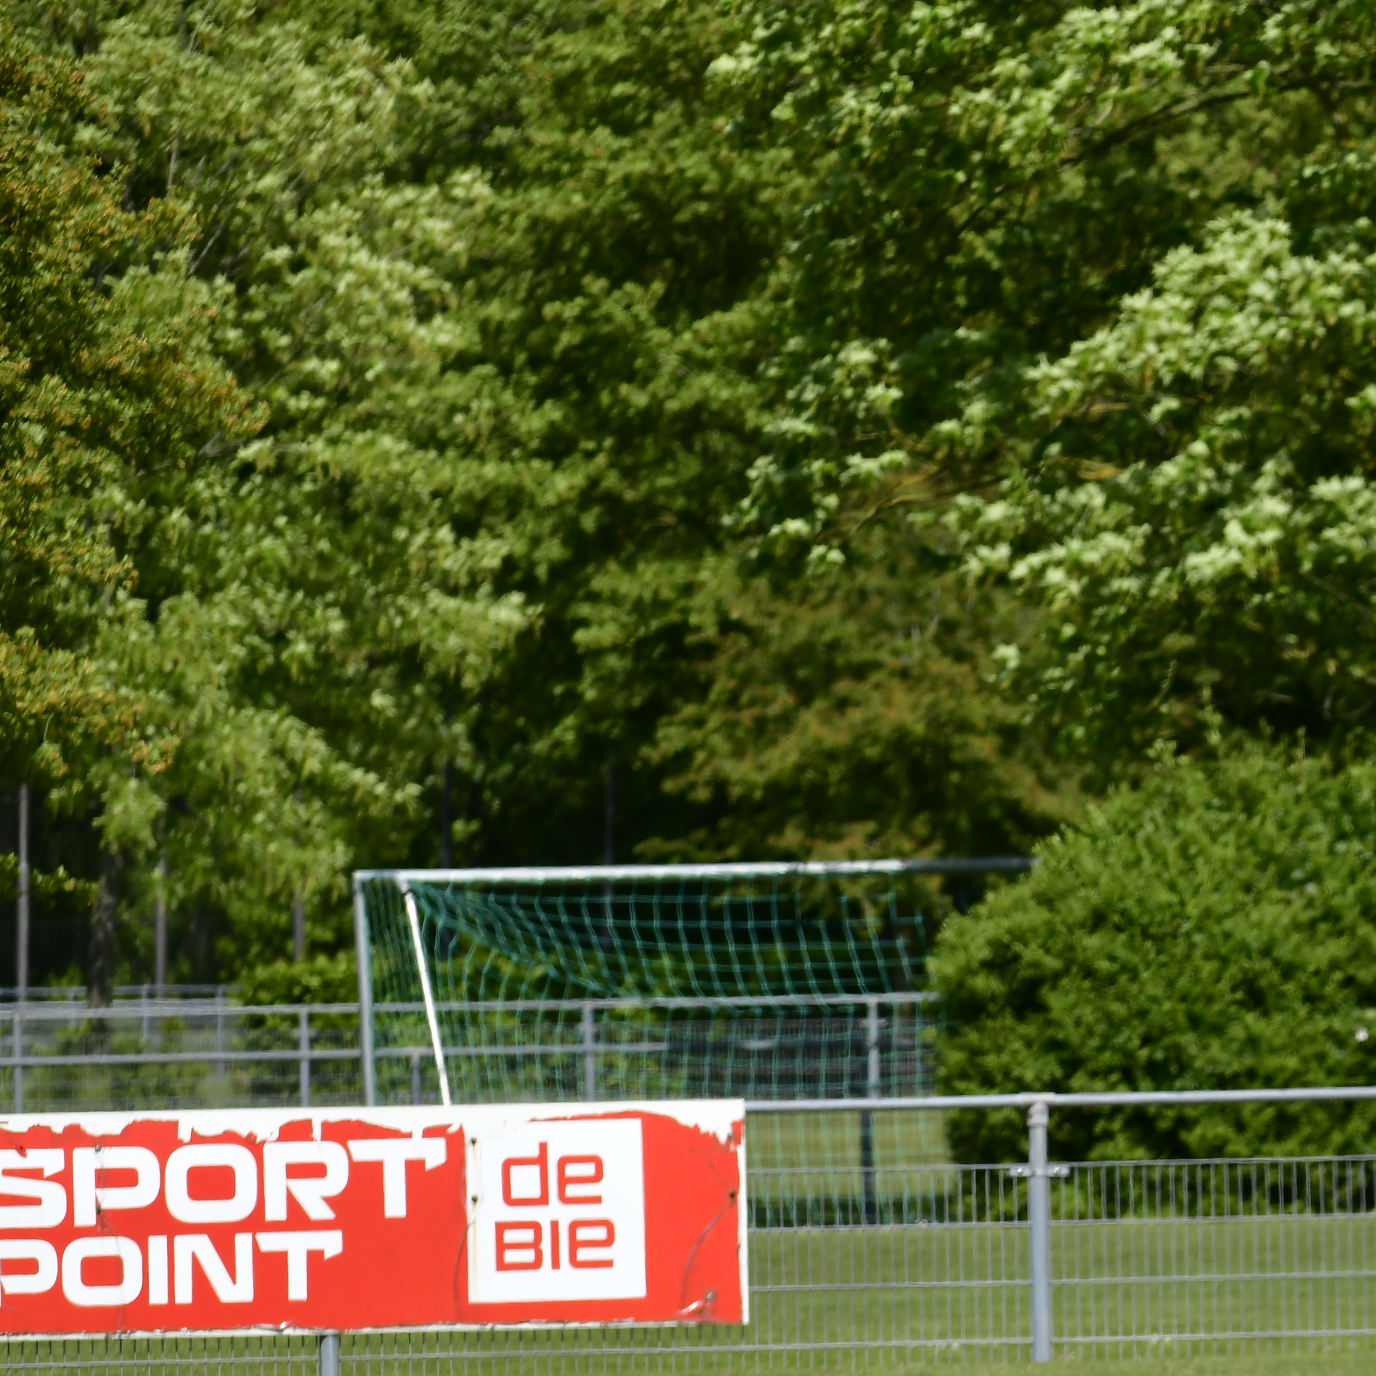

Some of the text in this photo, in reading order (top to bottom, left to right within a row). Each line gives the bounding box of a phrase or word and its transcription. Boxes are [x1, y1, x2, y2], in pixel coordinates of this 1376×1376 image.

[0, 1136, 447, 1229] SPORT
[501, 1142, 605, 1206] de
[0, 1229, 344, 1307] POINT
